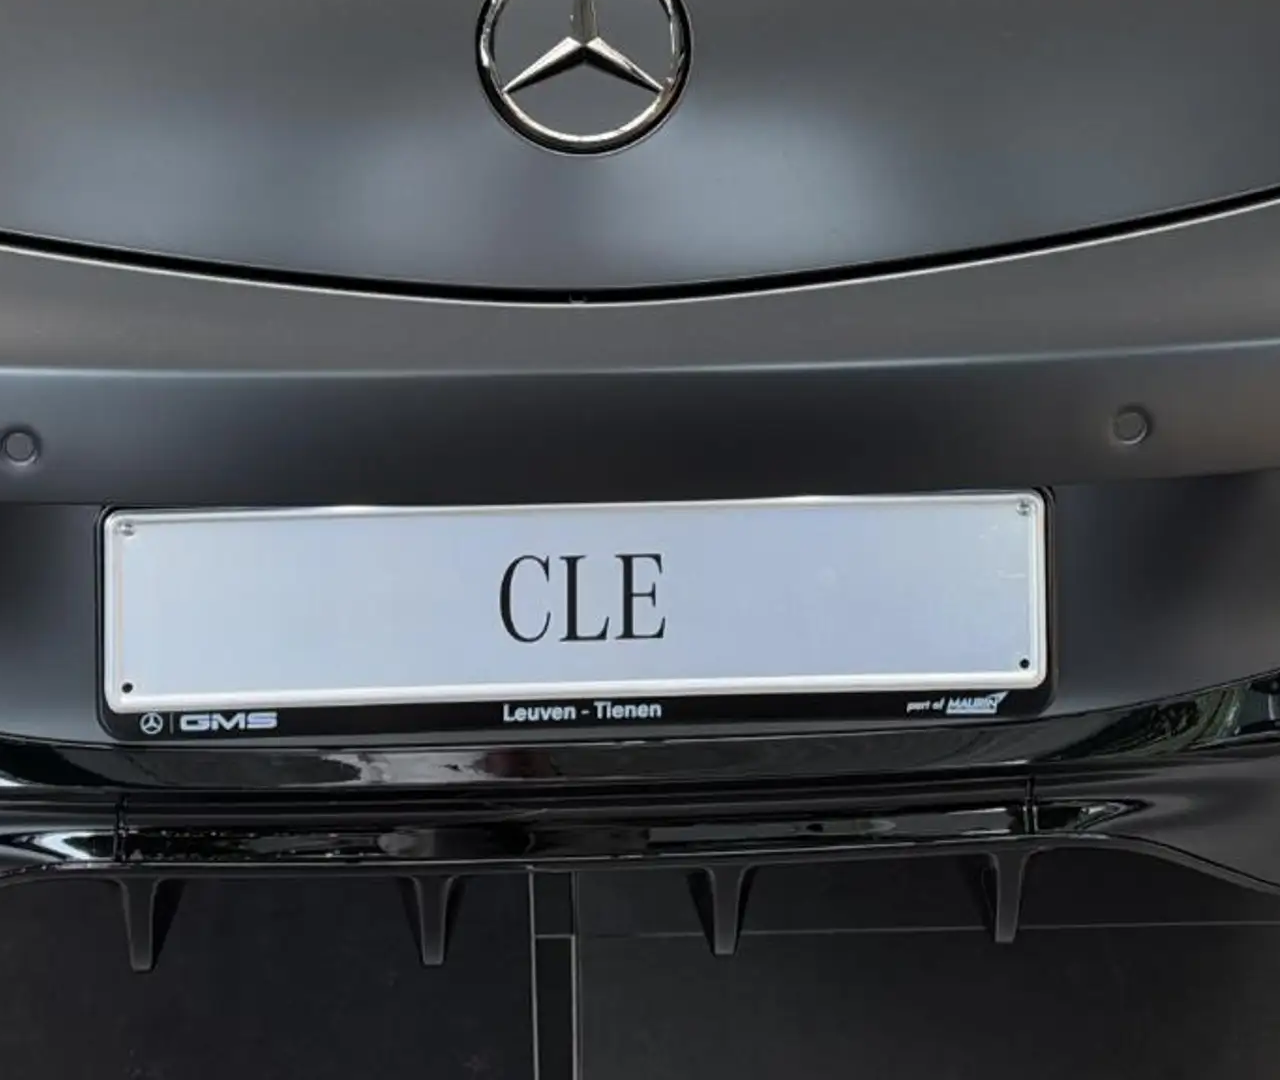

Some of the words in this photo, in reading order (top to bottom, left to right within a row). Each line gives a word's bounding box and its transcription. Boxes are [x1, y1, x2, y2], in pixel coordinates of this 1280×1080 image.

[500, 554, 666, 643] CLE
[179, 712, 278, 731] GMS
[503, 703, 576, 722] Leuven
[593, 700, 662, 719] Tienen
